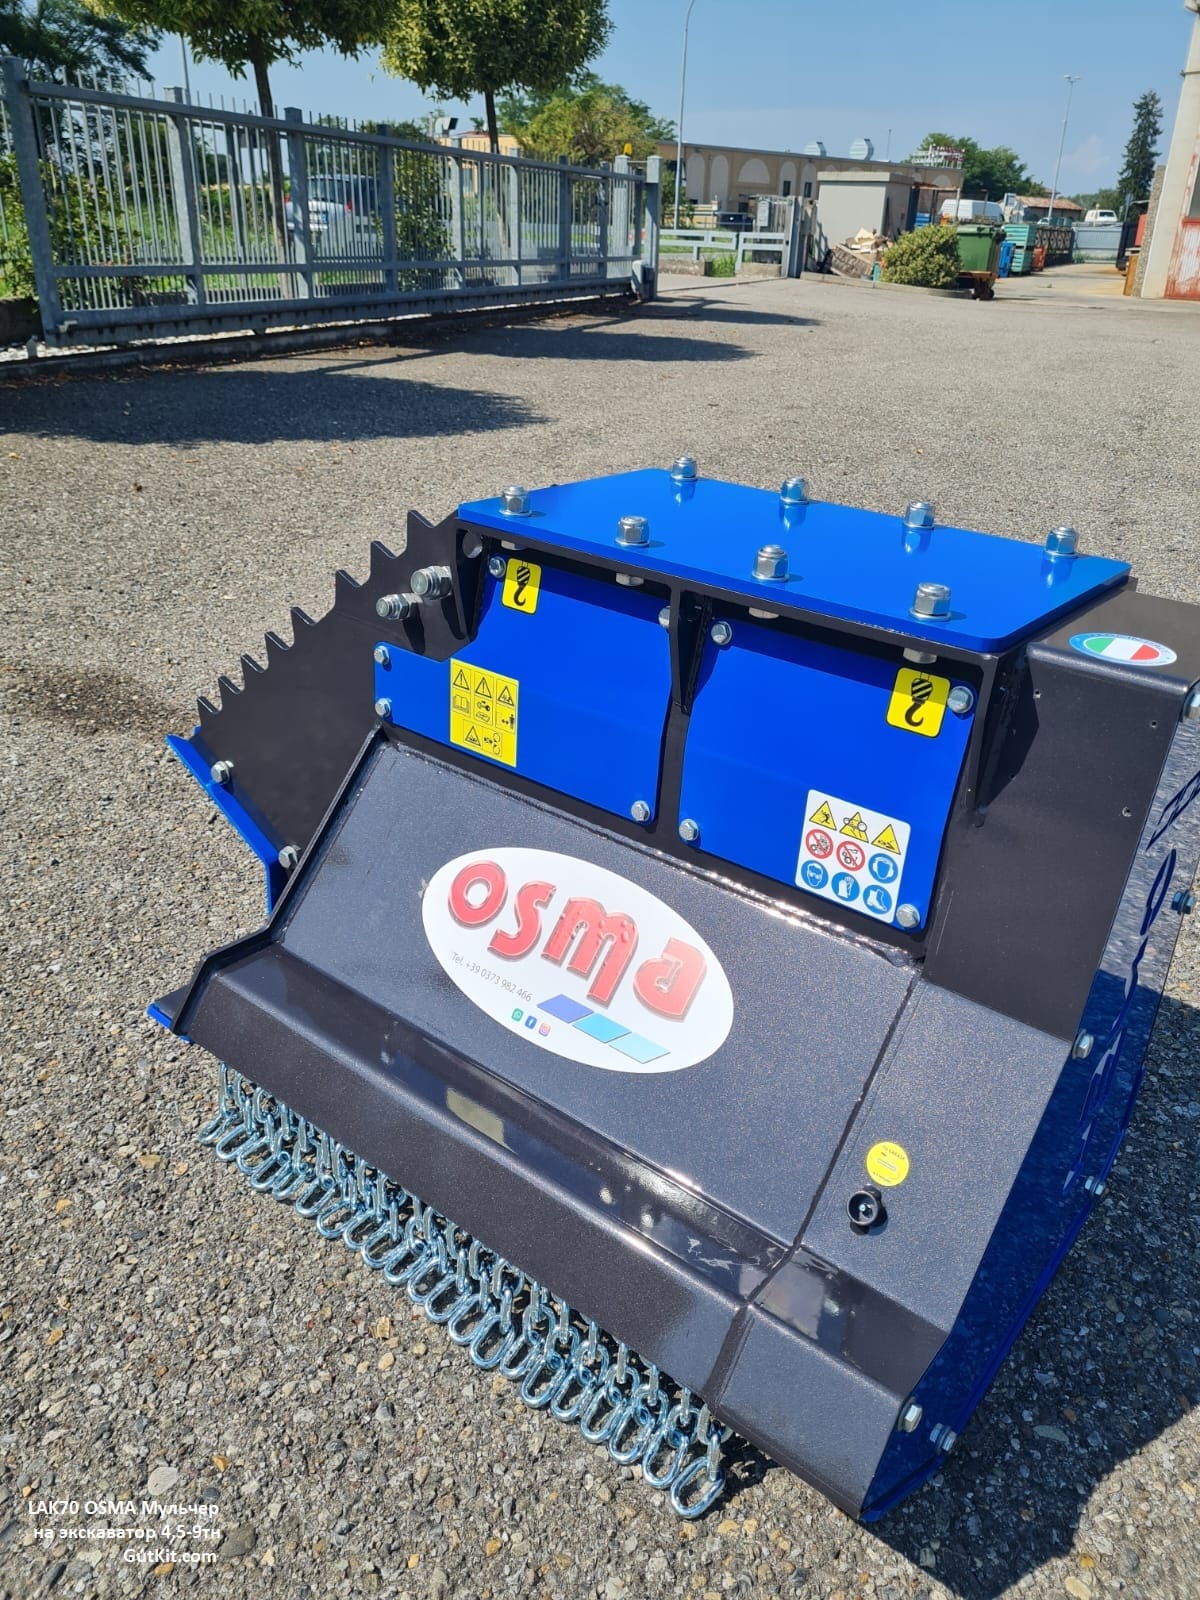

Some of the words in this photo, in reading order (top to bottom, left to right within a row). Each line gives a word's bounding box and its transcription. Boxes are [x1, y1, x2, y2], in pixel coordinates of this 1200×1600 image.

[451, 951, 465, 966] Tel.
[466, 962, 481, 974] +39
[481, 968, 501, 985] 0373
[501, 979, 517, 994] 982
[516, 988, 533, 1002] 466
